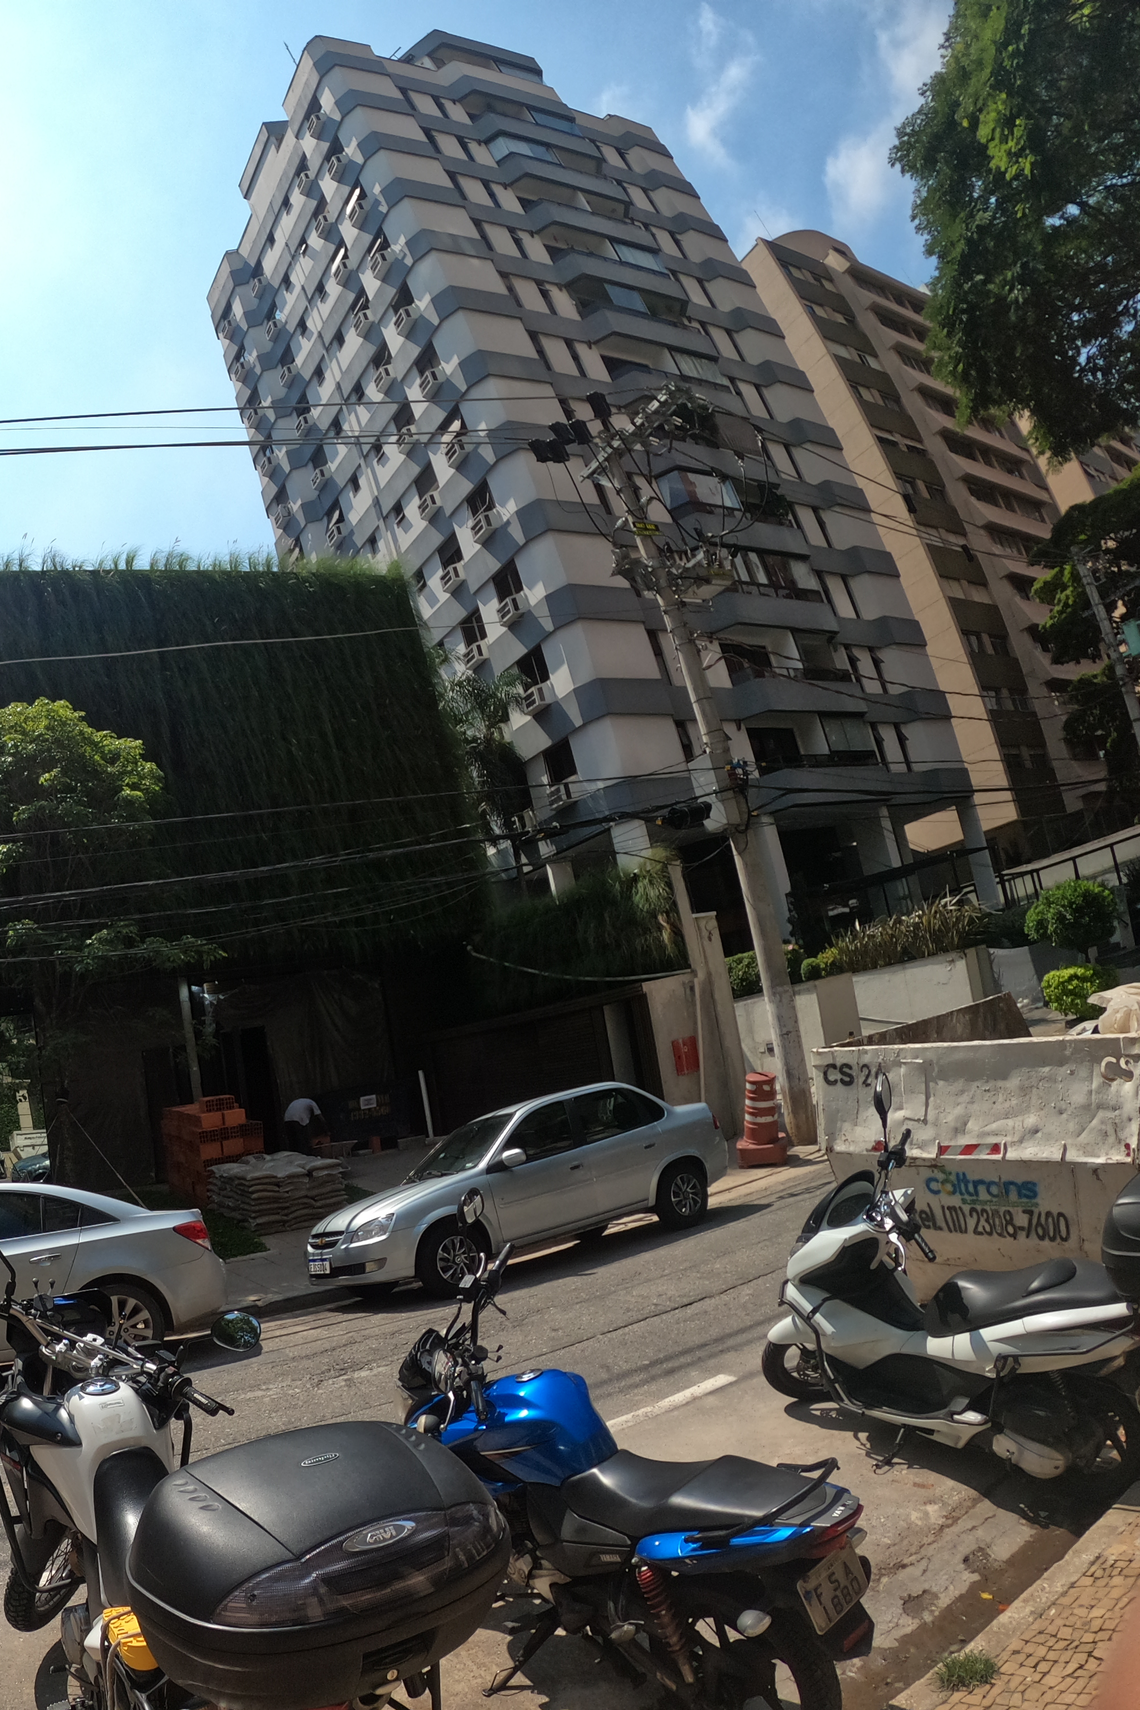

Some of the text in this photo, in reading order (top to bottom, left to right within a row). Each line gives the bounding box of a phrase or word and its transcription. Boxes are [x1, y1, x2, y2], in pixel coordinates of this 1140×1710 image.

[823, 1063, 855, 1086] CS
[1101, 1056, 1135, 1083] CS
[969, 1207, 1071, 1243] 2308-7600
[813, 1561, 854, 1606] FSA
